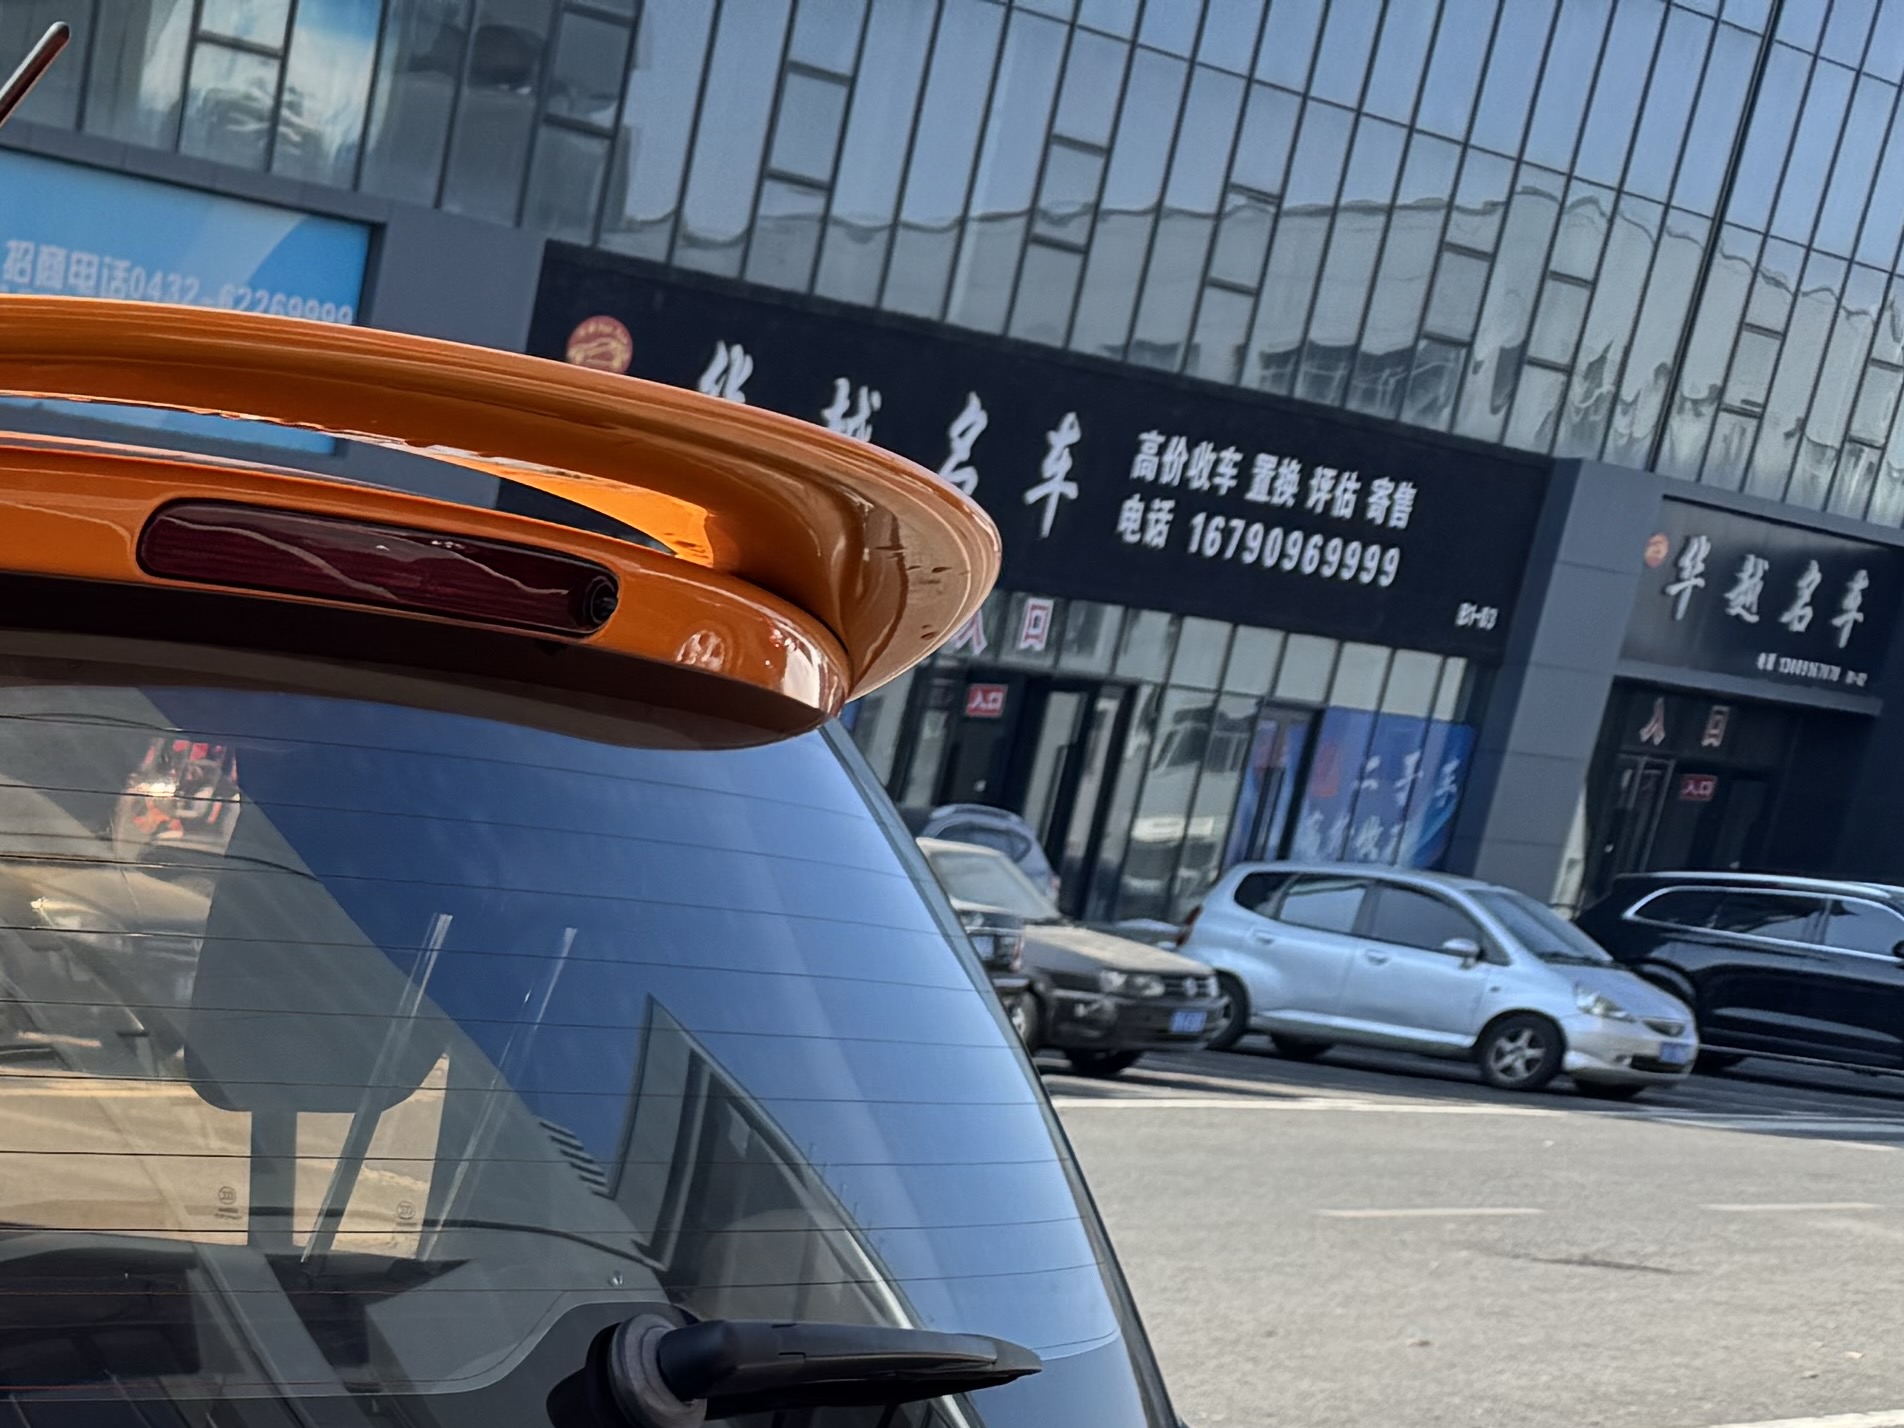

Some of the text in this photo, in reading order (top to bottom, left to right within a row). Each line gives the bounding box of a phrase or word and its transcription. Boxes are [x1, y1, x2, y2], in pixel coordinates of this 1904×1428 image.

[1130, 429, 1418, 530] 高价收车 置换 评估 寄售
[1115, 493, 1402, 588] 电话 16790969999
[1665, 535, 1871, 649] 华越名车
